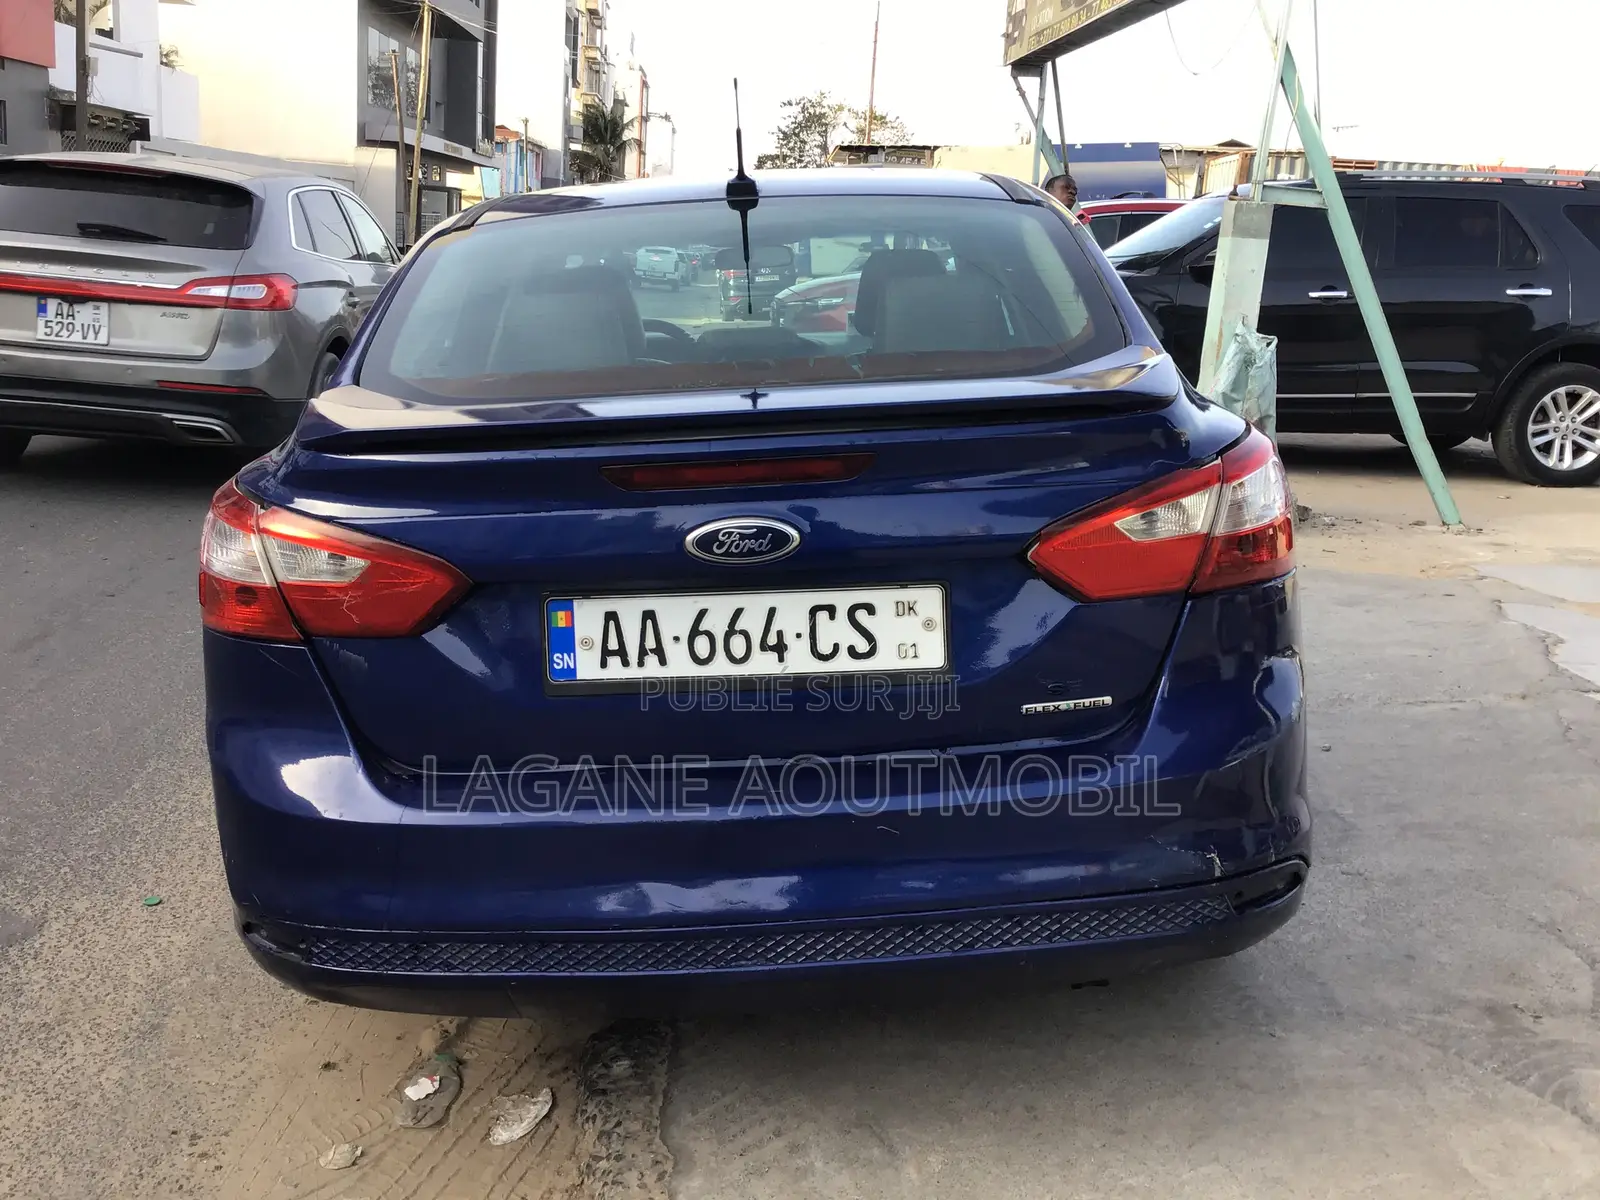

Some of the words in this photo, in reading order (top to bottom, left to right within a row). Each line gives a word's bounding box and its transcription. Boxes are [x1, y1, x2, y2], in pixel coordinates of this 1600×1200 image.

[712, 528, 773, 554] Ford
[895, 600, 919, 617] DK
[897, 642, 919, 660] 01
[552, 652, 575, 670] SN
[1024, 704, 1061, 715] FLEX
[1073, 698, 1110, 709] FUEL
